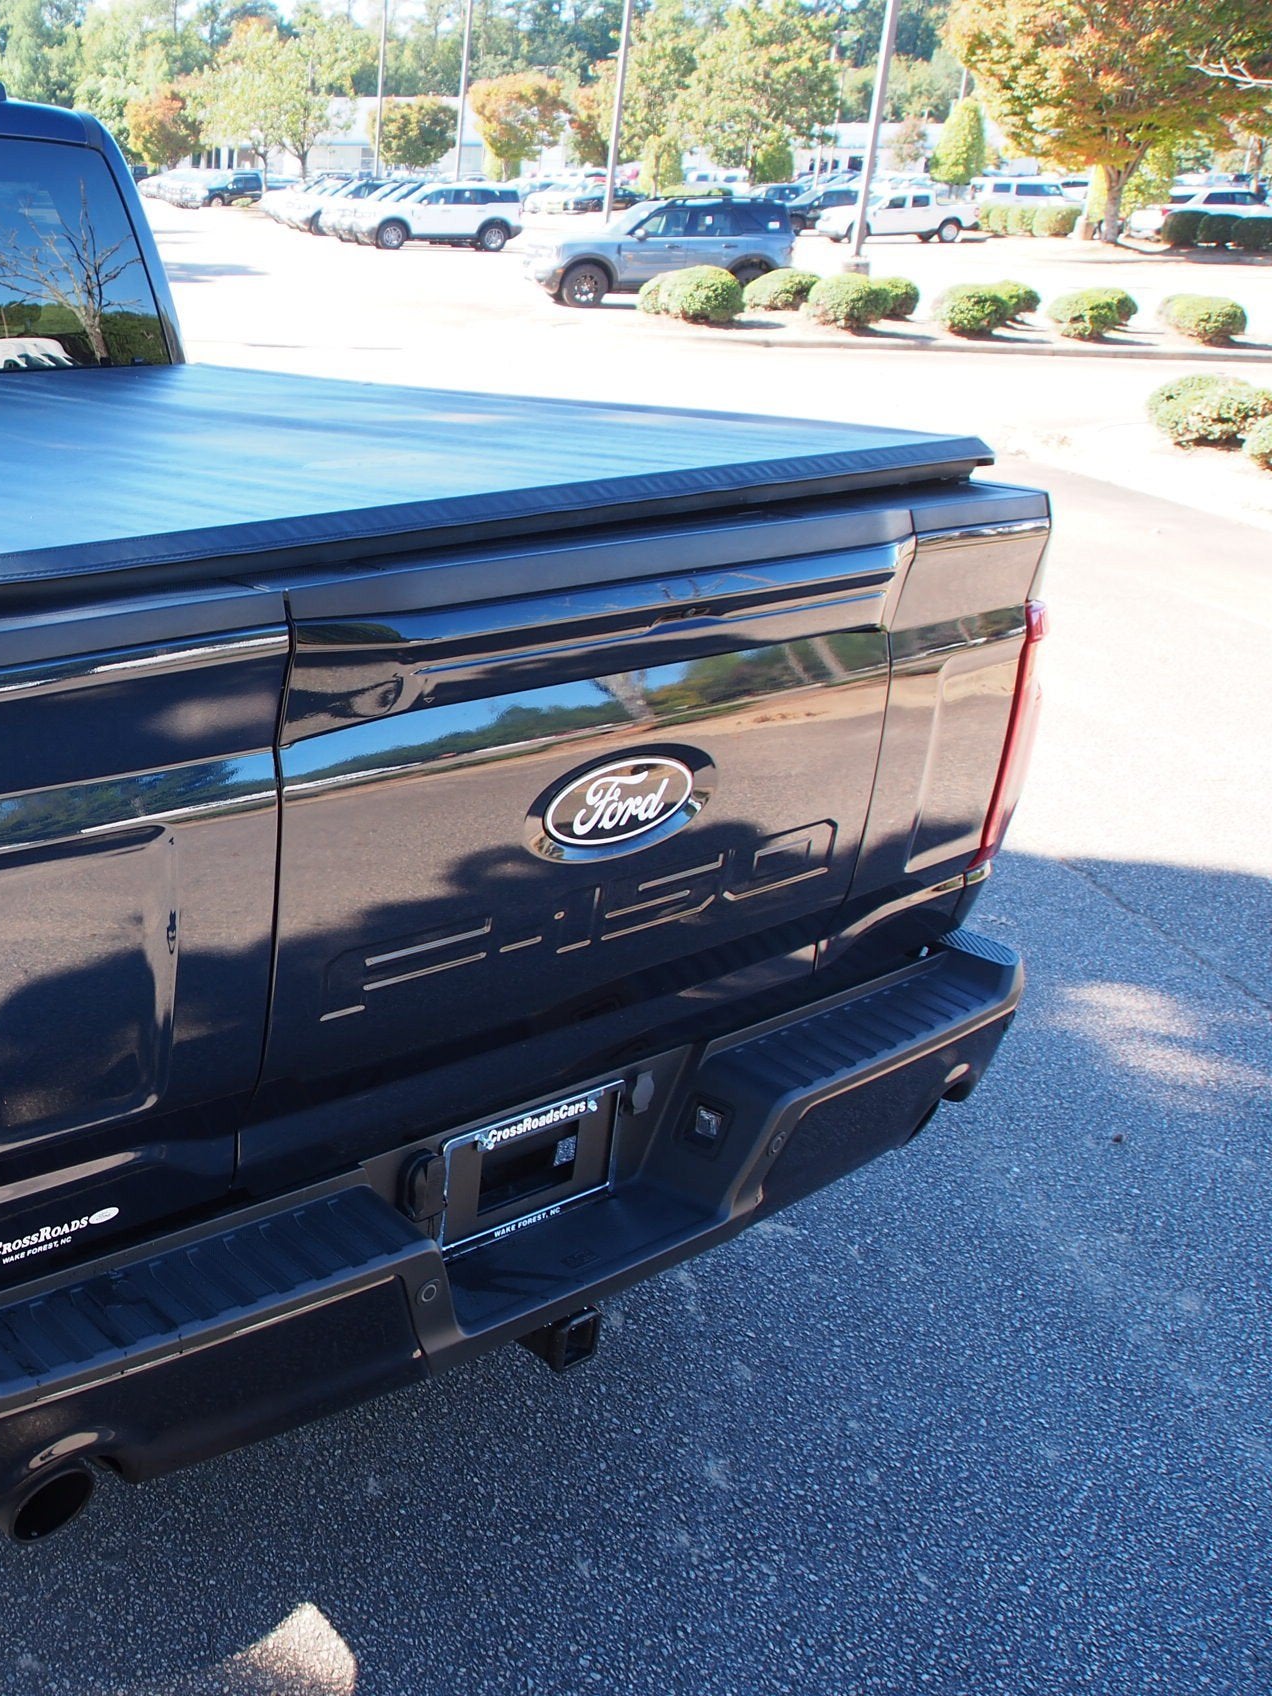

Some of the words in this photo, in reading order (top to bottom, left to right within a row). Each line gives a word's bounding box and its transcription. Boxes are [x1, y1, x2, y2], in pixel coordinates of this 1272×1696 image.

[572, 770, 670, 836] Ford
[319, 818, 839, 1022] F-150
[488, 1100, 586, 1145] CrossRoadsCars
[494, 1224, 516, 1238] WAKE
[517, 1213, 549, 1229] FOREST,
[549, 1206, 561, 1217] NC
[2, 1251, 26, 1265] WAKE
[26, 1240, 59, 1257] FOREST,
[60, 1236, 72, 1246] NC
